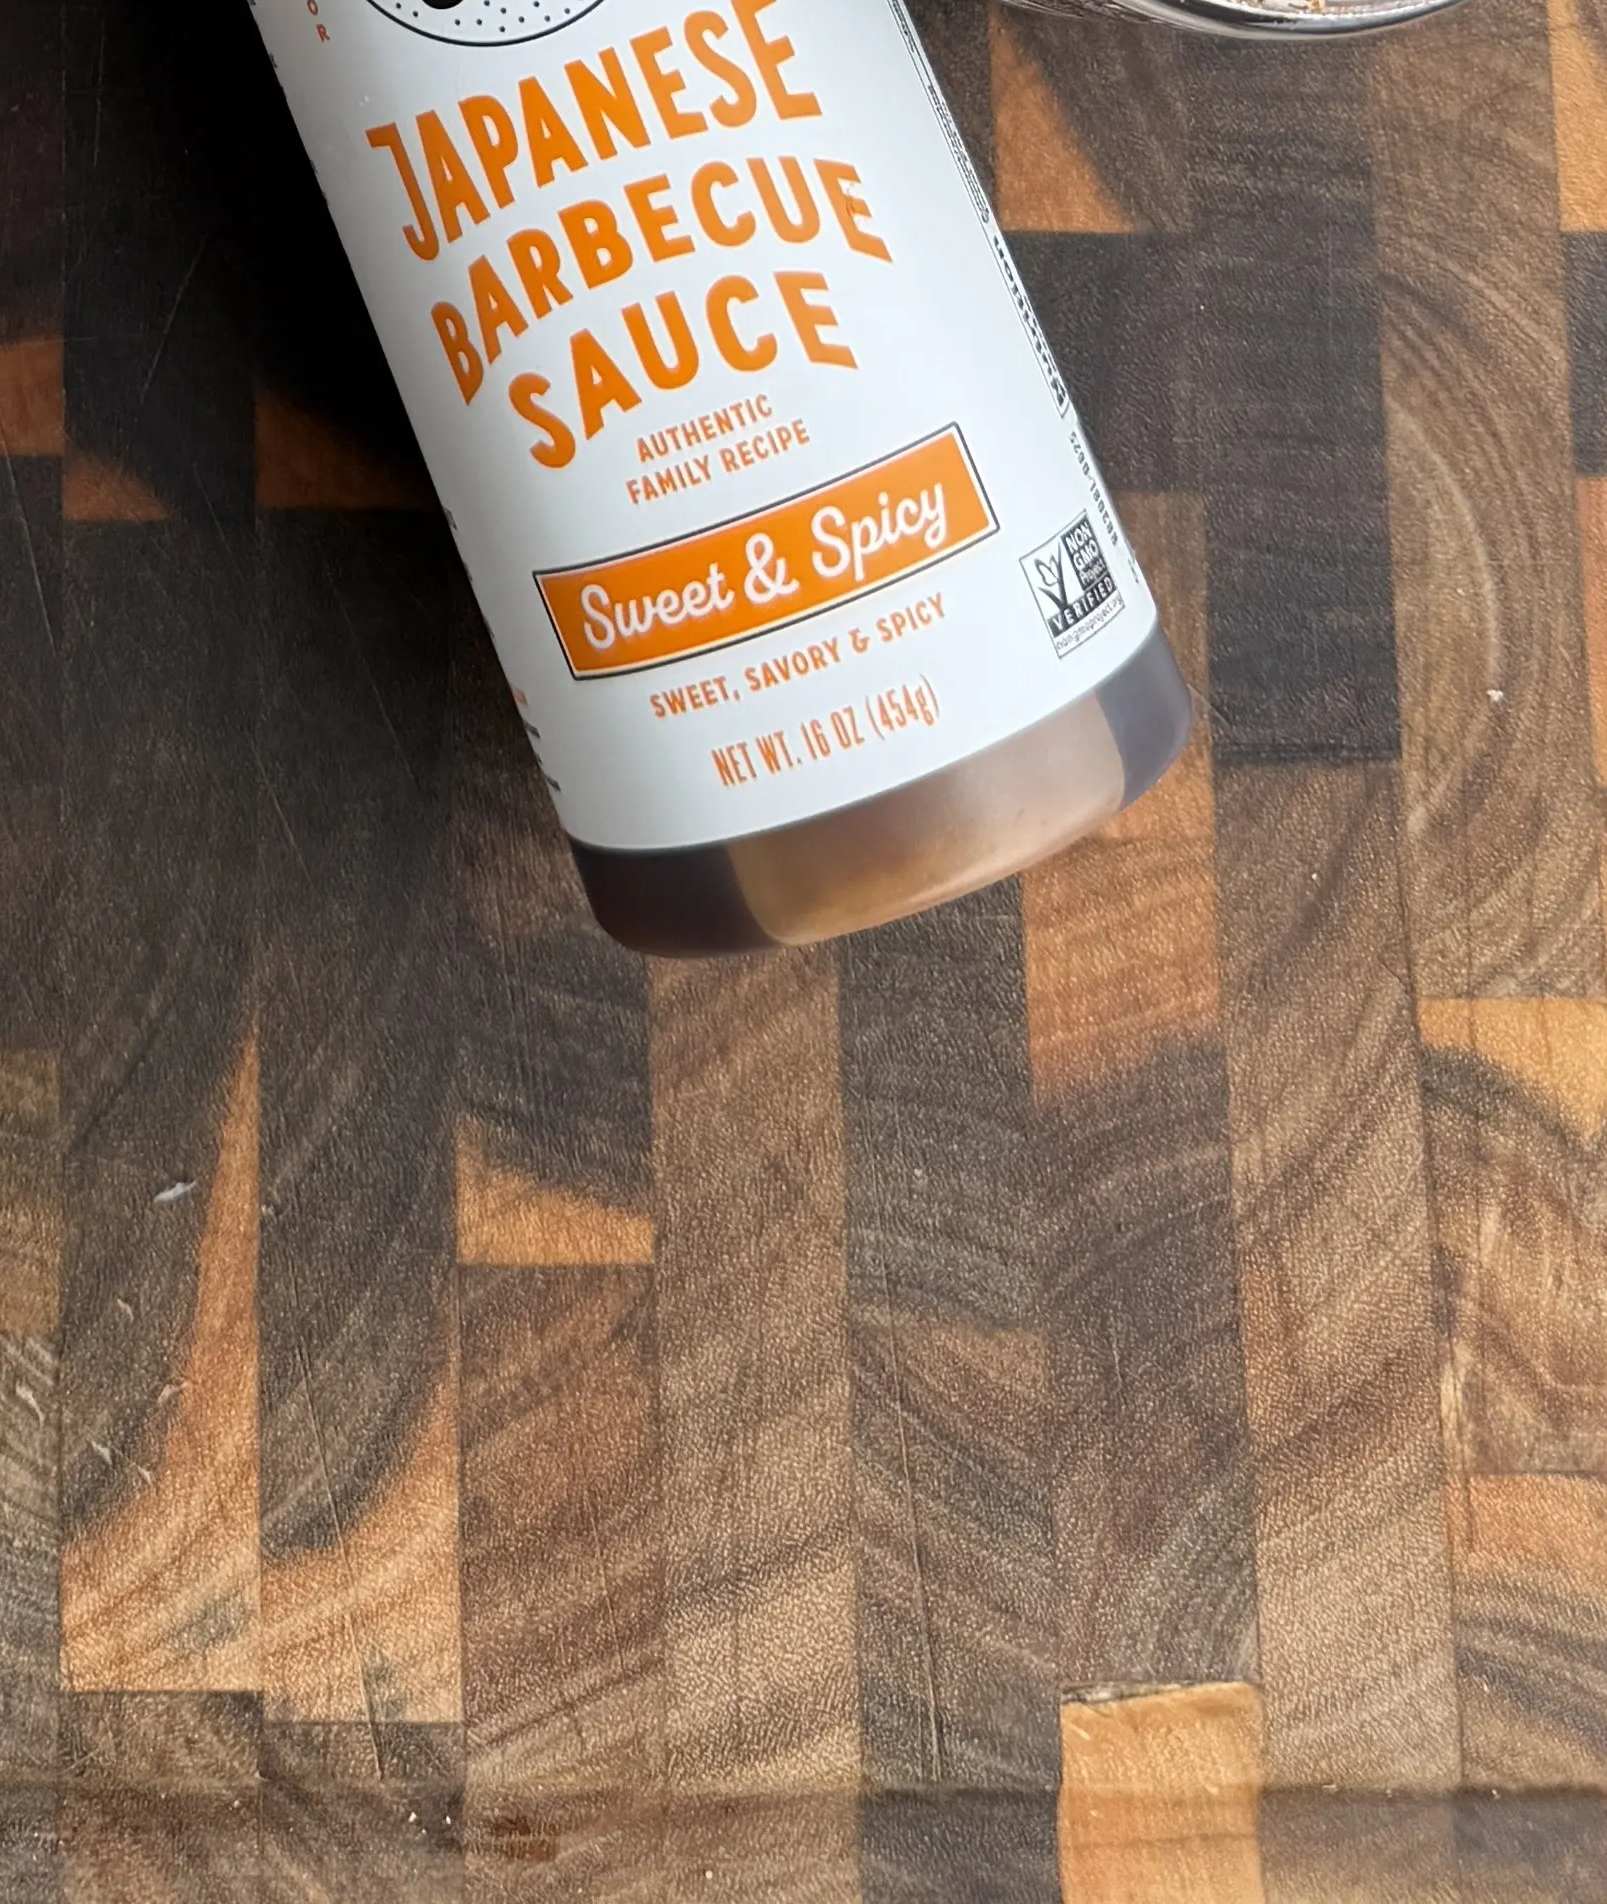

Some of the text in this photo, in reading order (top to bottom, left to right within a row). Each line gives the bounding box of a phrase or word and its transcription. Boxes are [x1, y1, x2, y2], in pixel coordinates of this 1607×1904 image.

[430, 157, 893, 406] BARBECUE
[508, 270, 858, 469] SAUCE
[625, 419, 810, 505] FAMILY RECIPE
[636, 393, 773, 464] AUTHENTIC
[580, 481, 946, 650] Sweet & Spicy
[1065, 521, 1094, 552] NON
[1073, 541, 1100, 569] GMO
[1052, 575, 1114, 631] VERIFIED
[650, 593, 947, 718] SWEET, SAVORY & SPICY
[712, 673, 942, 787] NET WT. 16 OZ (454g)
